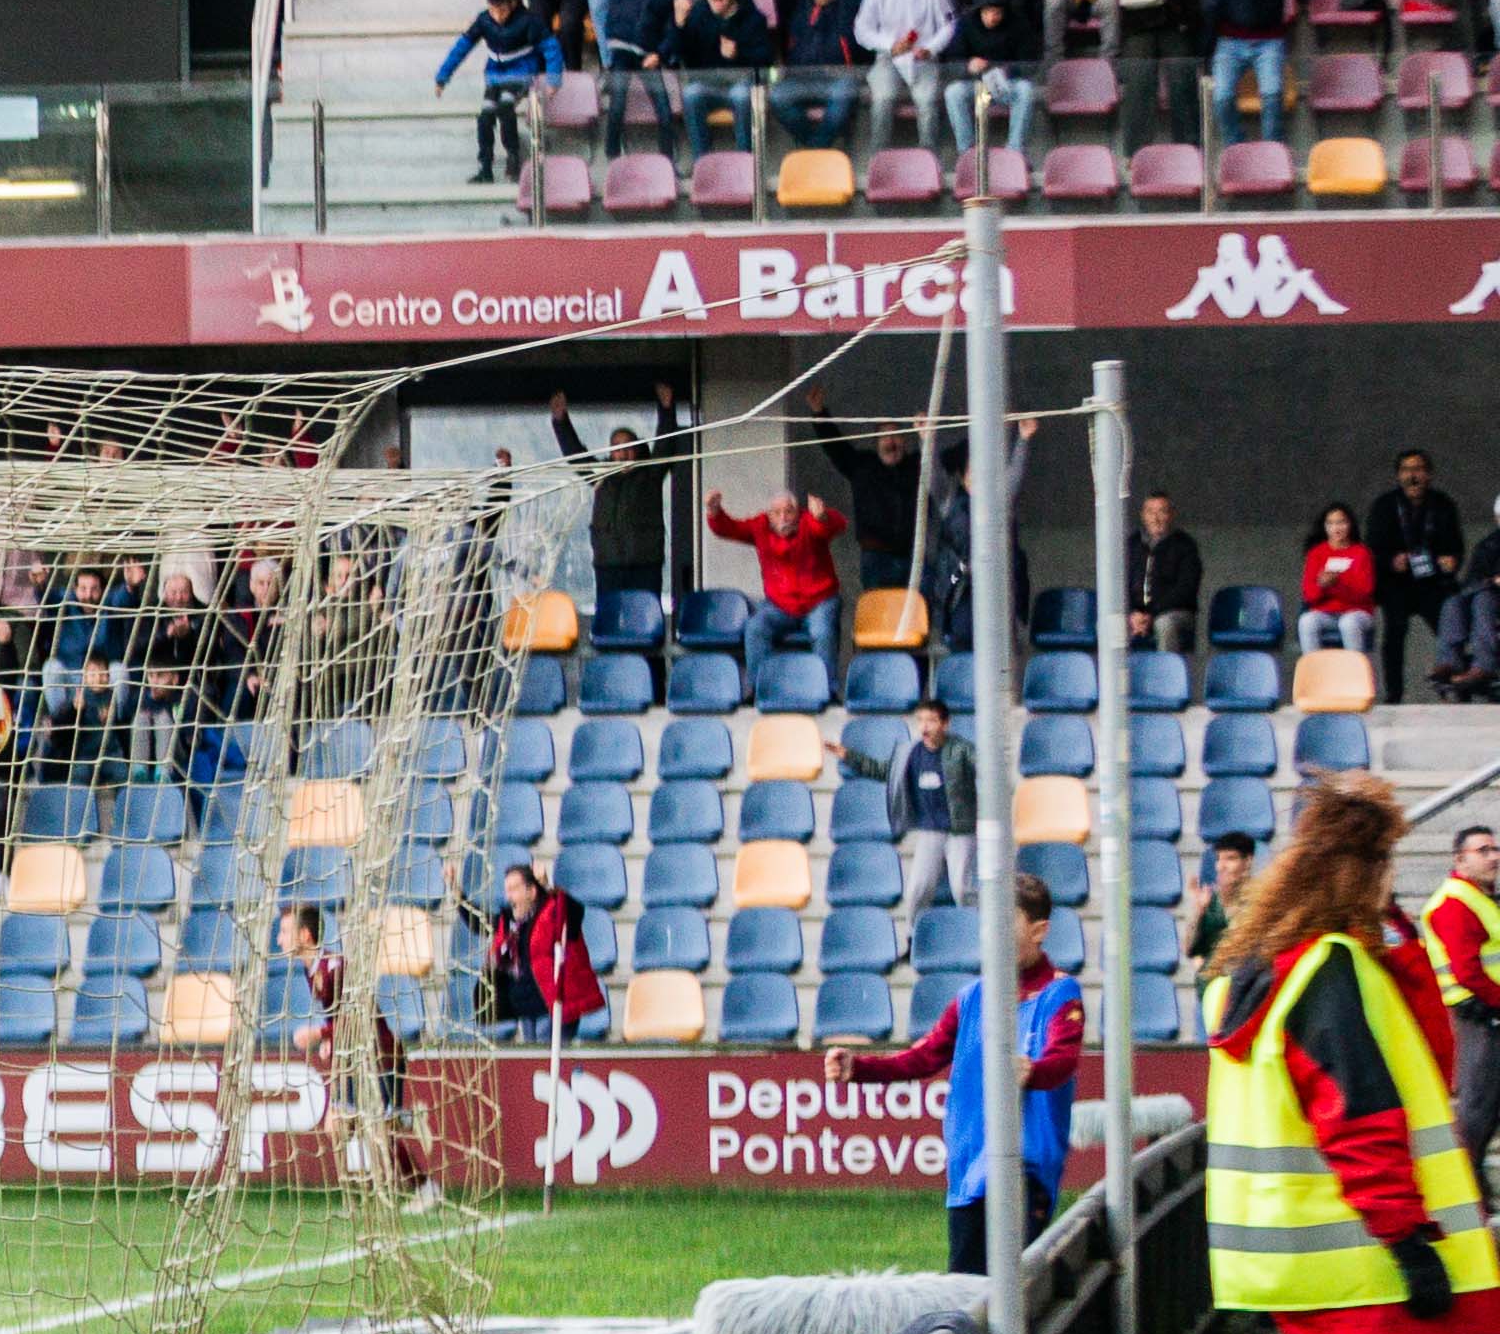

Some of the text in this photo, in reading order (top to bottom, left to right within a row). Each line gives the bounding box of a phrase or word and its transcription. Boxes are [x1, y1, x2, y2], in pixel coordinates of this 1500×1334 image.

[329, 291, 443, 327] Centro
[451, 285, 623, 323] Comercial
[639, 250, 706, 320] A
[709, 1127, 949, 1175] Ponteve
